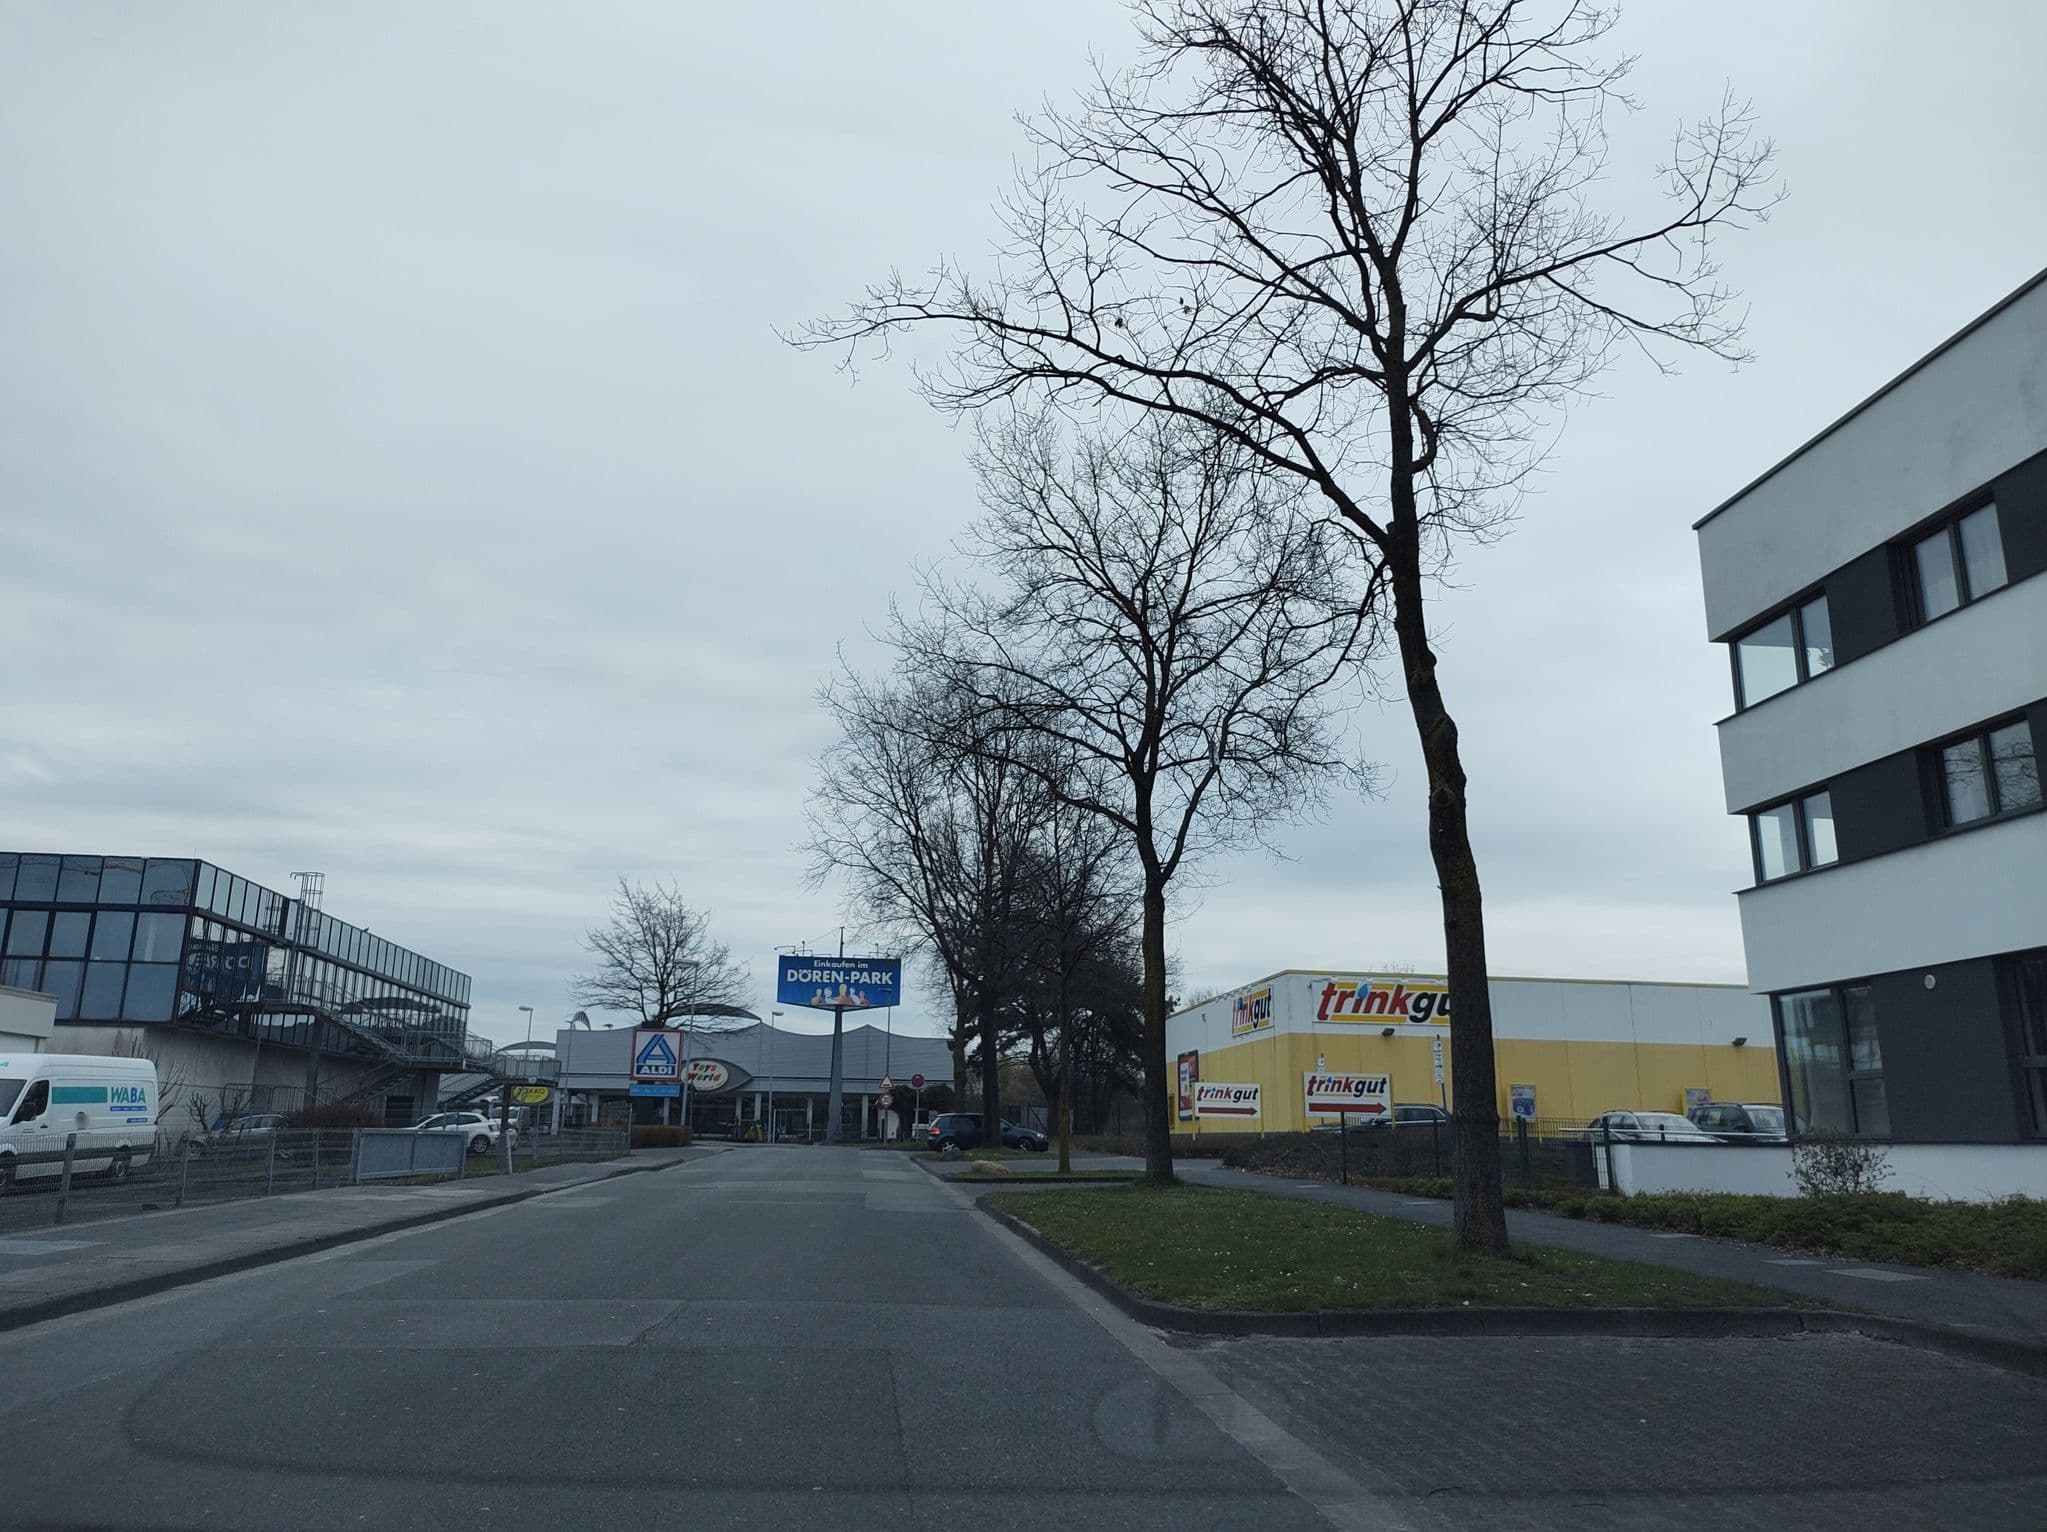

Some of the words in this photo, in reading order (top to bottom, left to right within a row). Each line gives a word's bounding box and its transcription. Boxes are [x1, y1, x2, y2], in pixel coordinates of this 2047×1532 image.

[814, 960, 855, 969] Einkaufen
[857, 960, 868, 969] im
[787, 969, 893, 985] DÖREN-PARK
[639, 1065, 672, 1075] ALDI
[692, 1063, 717, 1073] Toys
[688, 1072, 722, 1081] World
[1307, 1075, 1387, 1098] trinkgut
[111, 1087, 146, 1103] WABA
[1197, 1086, 1259, 1103] trinkgut
